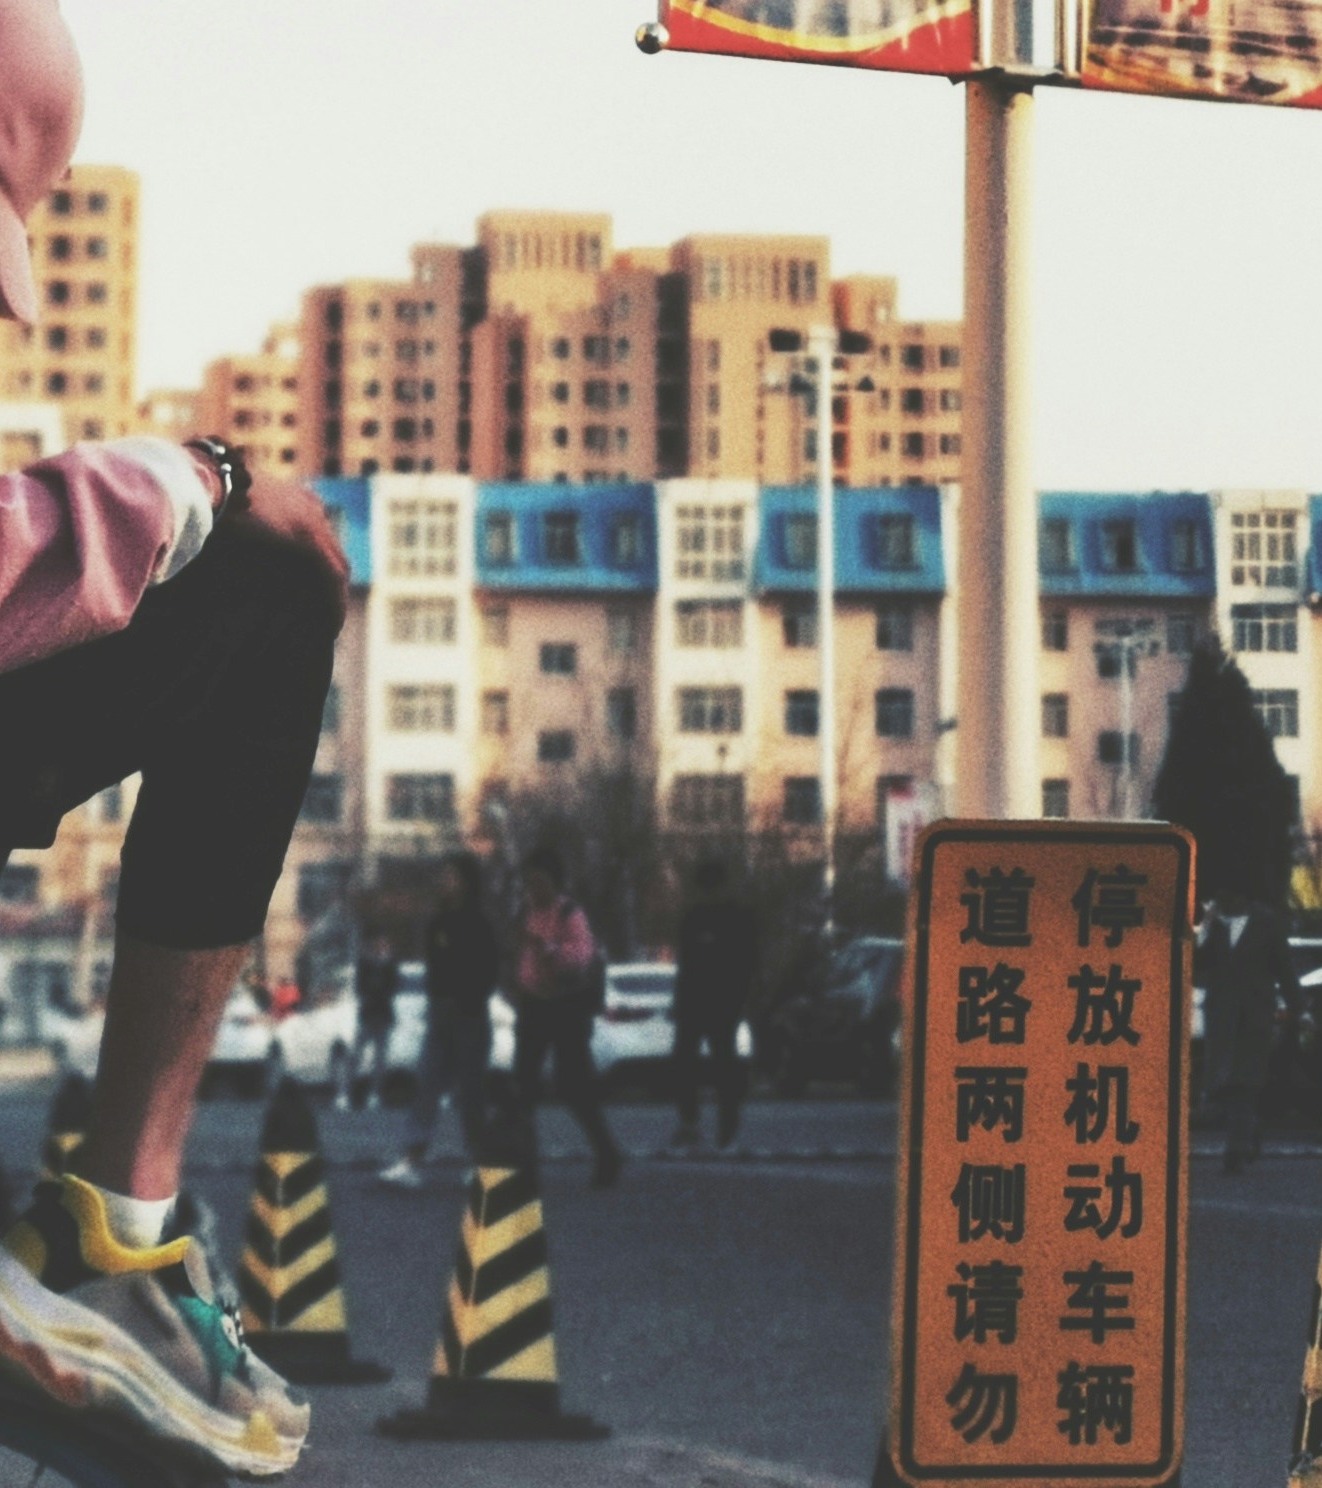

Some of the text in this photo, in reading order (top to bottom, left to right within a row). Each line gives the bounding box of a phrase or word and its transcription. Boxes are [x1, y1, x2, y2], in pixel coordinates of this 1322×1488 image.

[945, 865, 1036, 1444] 道路两侧请勿
[1055, 862, 1149, 1445] 停放机动车辆
